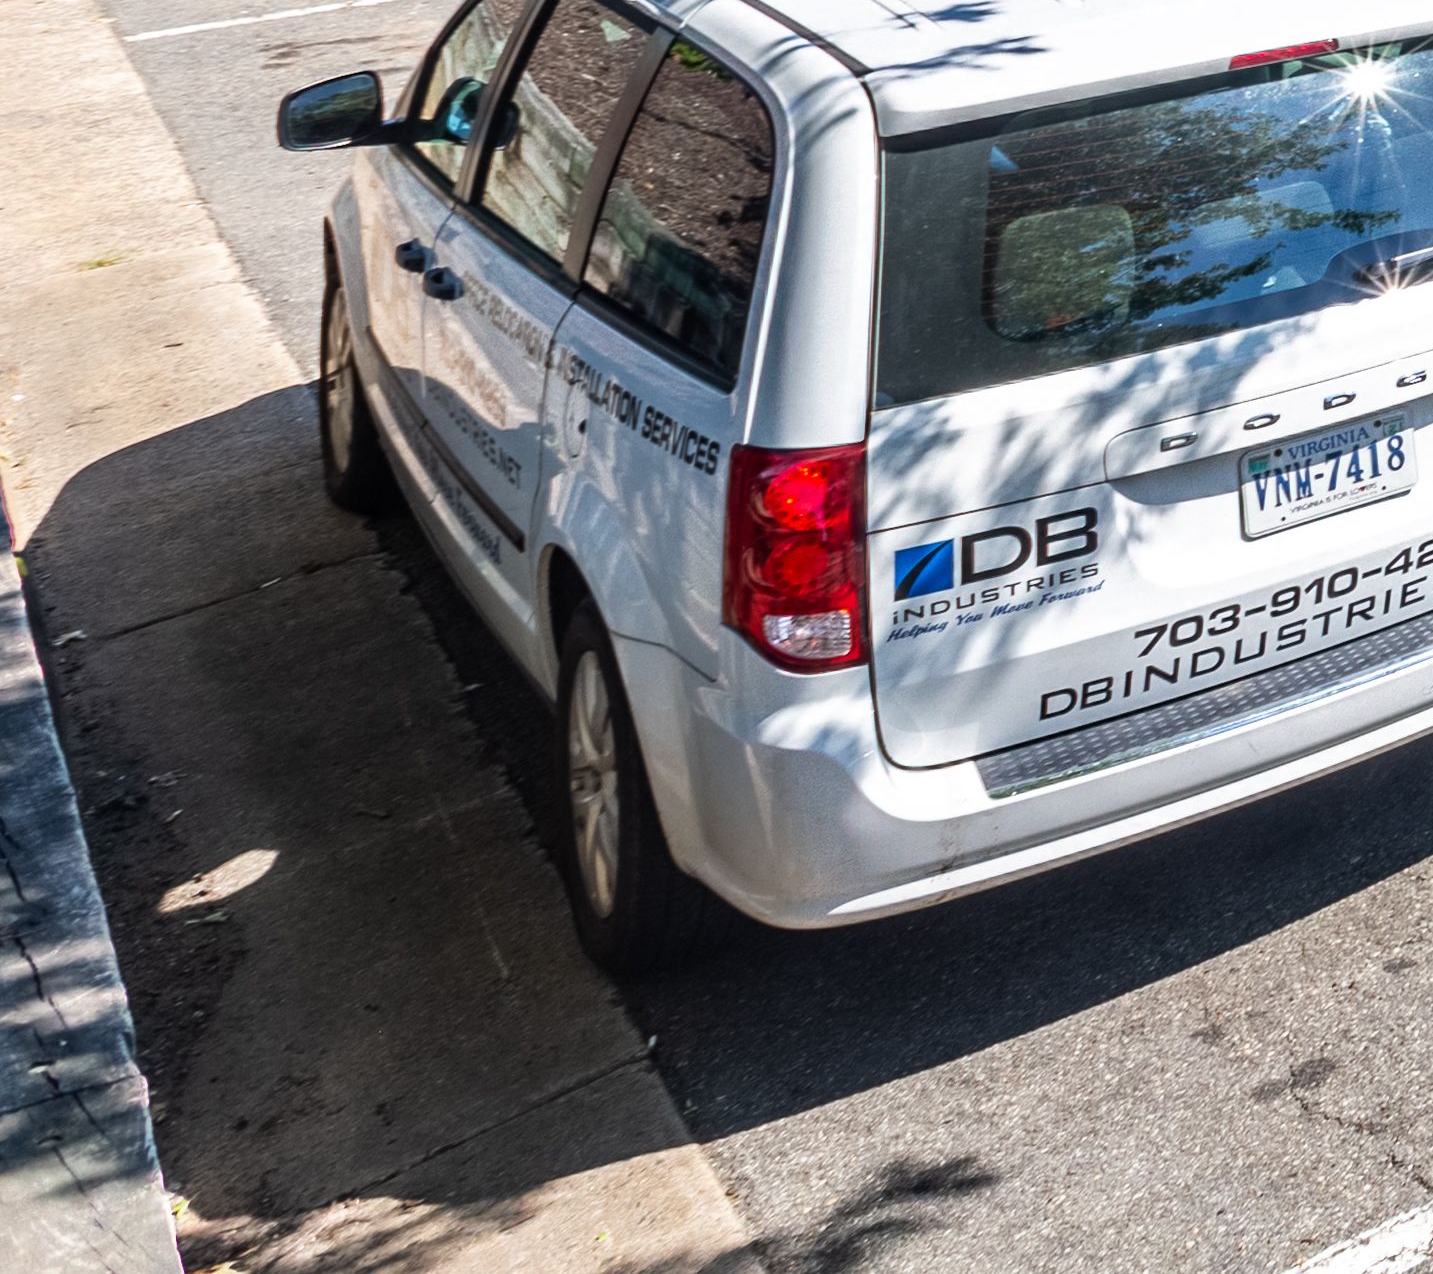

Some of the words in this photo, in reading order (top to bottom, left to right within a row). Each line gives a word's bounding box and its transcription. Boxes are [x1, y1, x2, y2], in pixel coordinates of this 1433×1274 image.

[641, 404, 721, 476] SERVICES
[1252, 434, 1406, 511] VNM-7418
[1287, 426, 1371, 460] VIRGINIA
[961, 506, 1098, 586] DB
[886, 620, 949, 642] Helping
[955, 610, 984, 626] You
[989, 599, 1034, 619] Move
[1039, 579, 1105, 606] Forward
